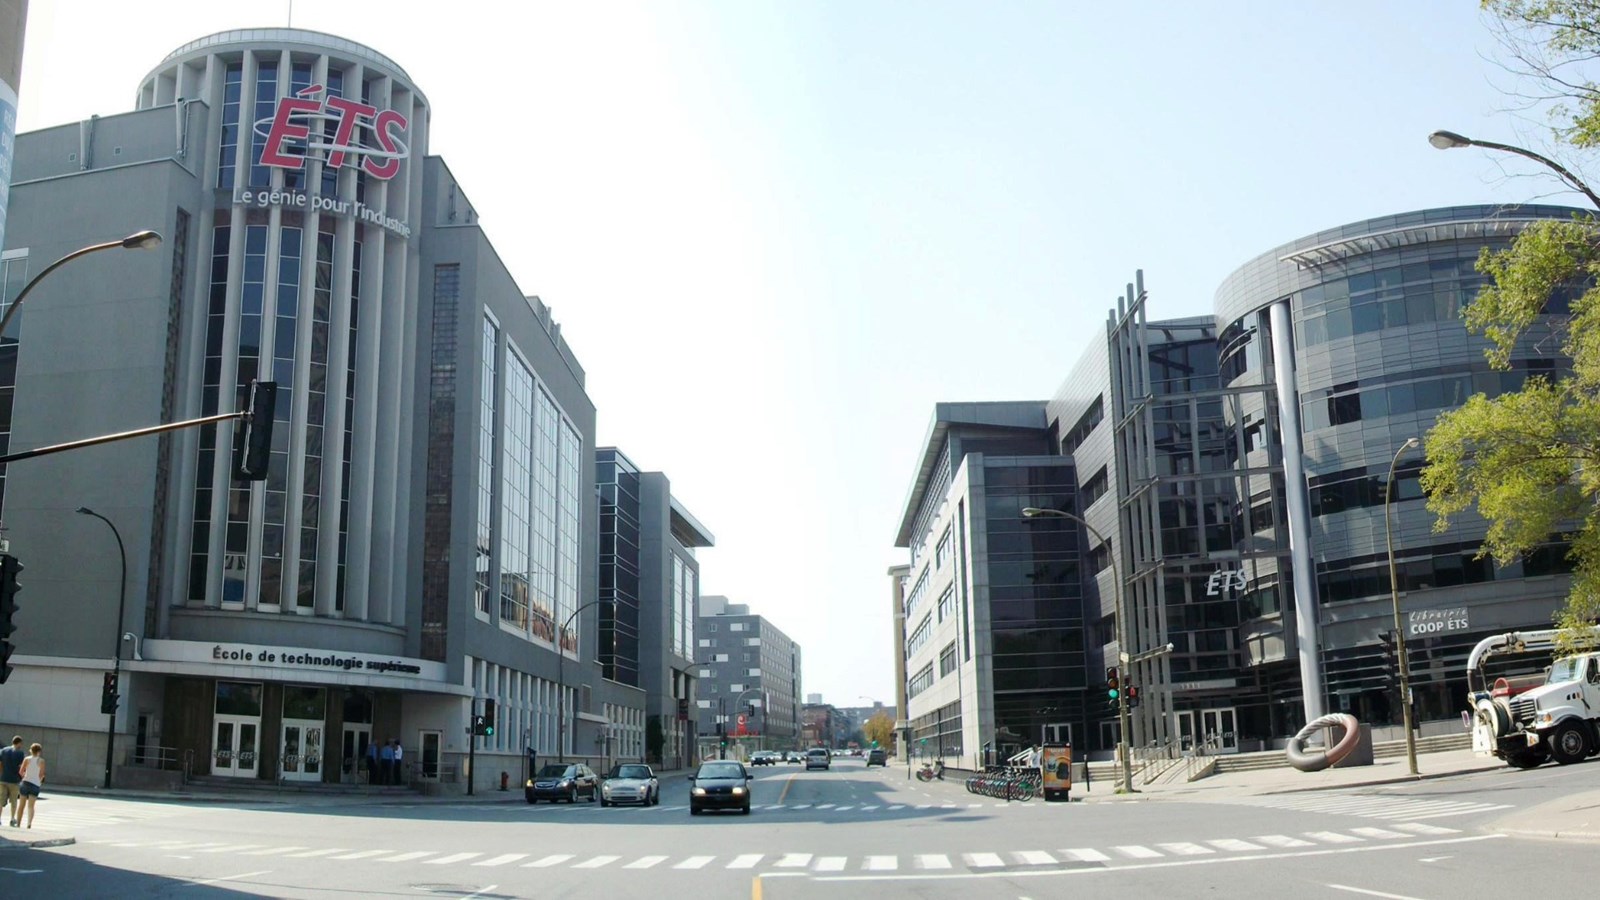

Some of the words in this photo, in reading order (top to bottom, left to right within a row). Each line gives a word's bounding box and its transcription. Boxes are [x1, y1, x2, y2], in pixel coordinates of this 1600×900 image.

[259, 84, 408, 180] ÉTS
[233, 190, 252, 203] Le
[257, 189, 307, 207] génie
[311, 195, 350, 214] pour
[1207, 569, 1247, 596] ÉTS
[1411, 621, 1444, 634] COOP
[1448, 617, 1468, 630] ÉTS
[213, 645, 253, 661] École
[258, 650, 276, 663] de
[281, 652, 363, 670] technologie
[366, 660, 421, 674] supériee
